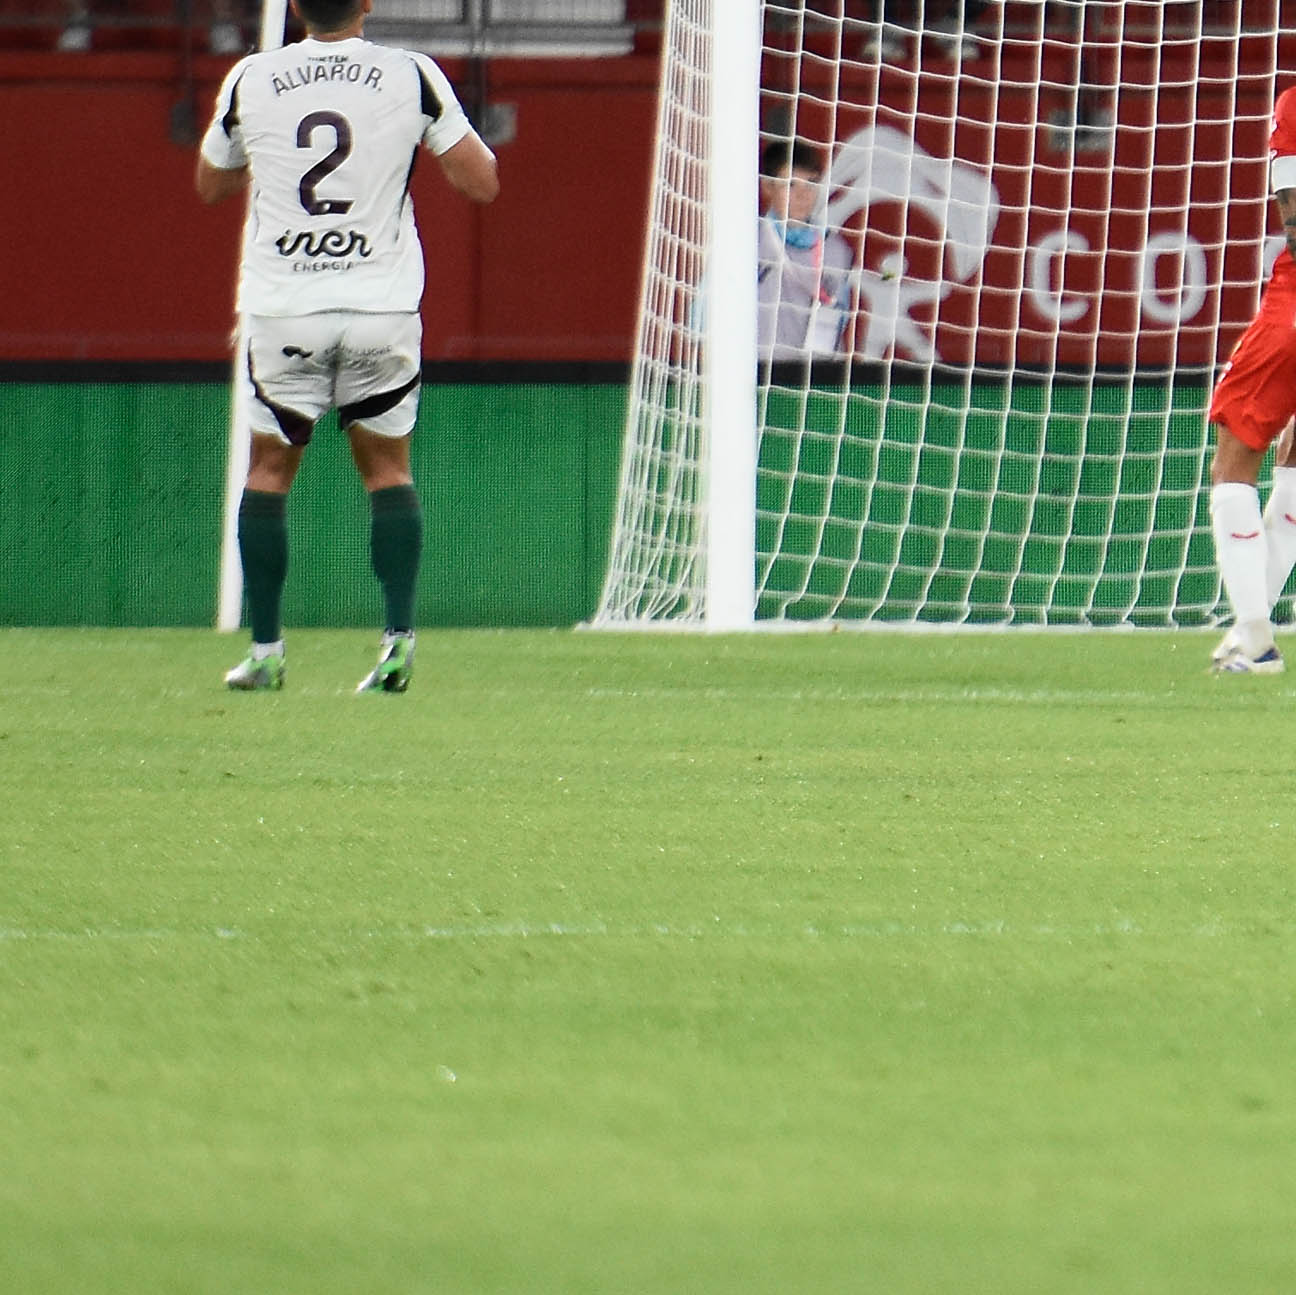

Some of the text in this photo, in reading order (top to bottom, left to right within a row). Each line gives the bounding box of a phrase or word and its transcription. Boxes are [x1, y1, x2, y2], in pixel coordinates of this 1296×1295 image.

[272, 63, 383, 97] ÁLVARO R.
[296, 110, 355, 216] 2
